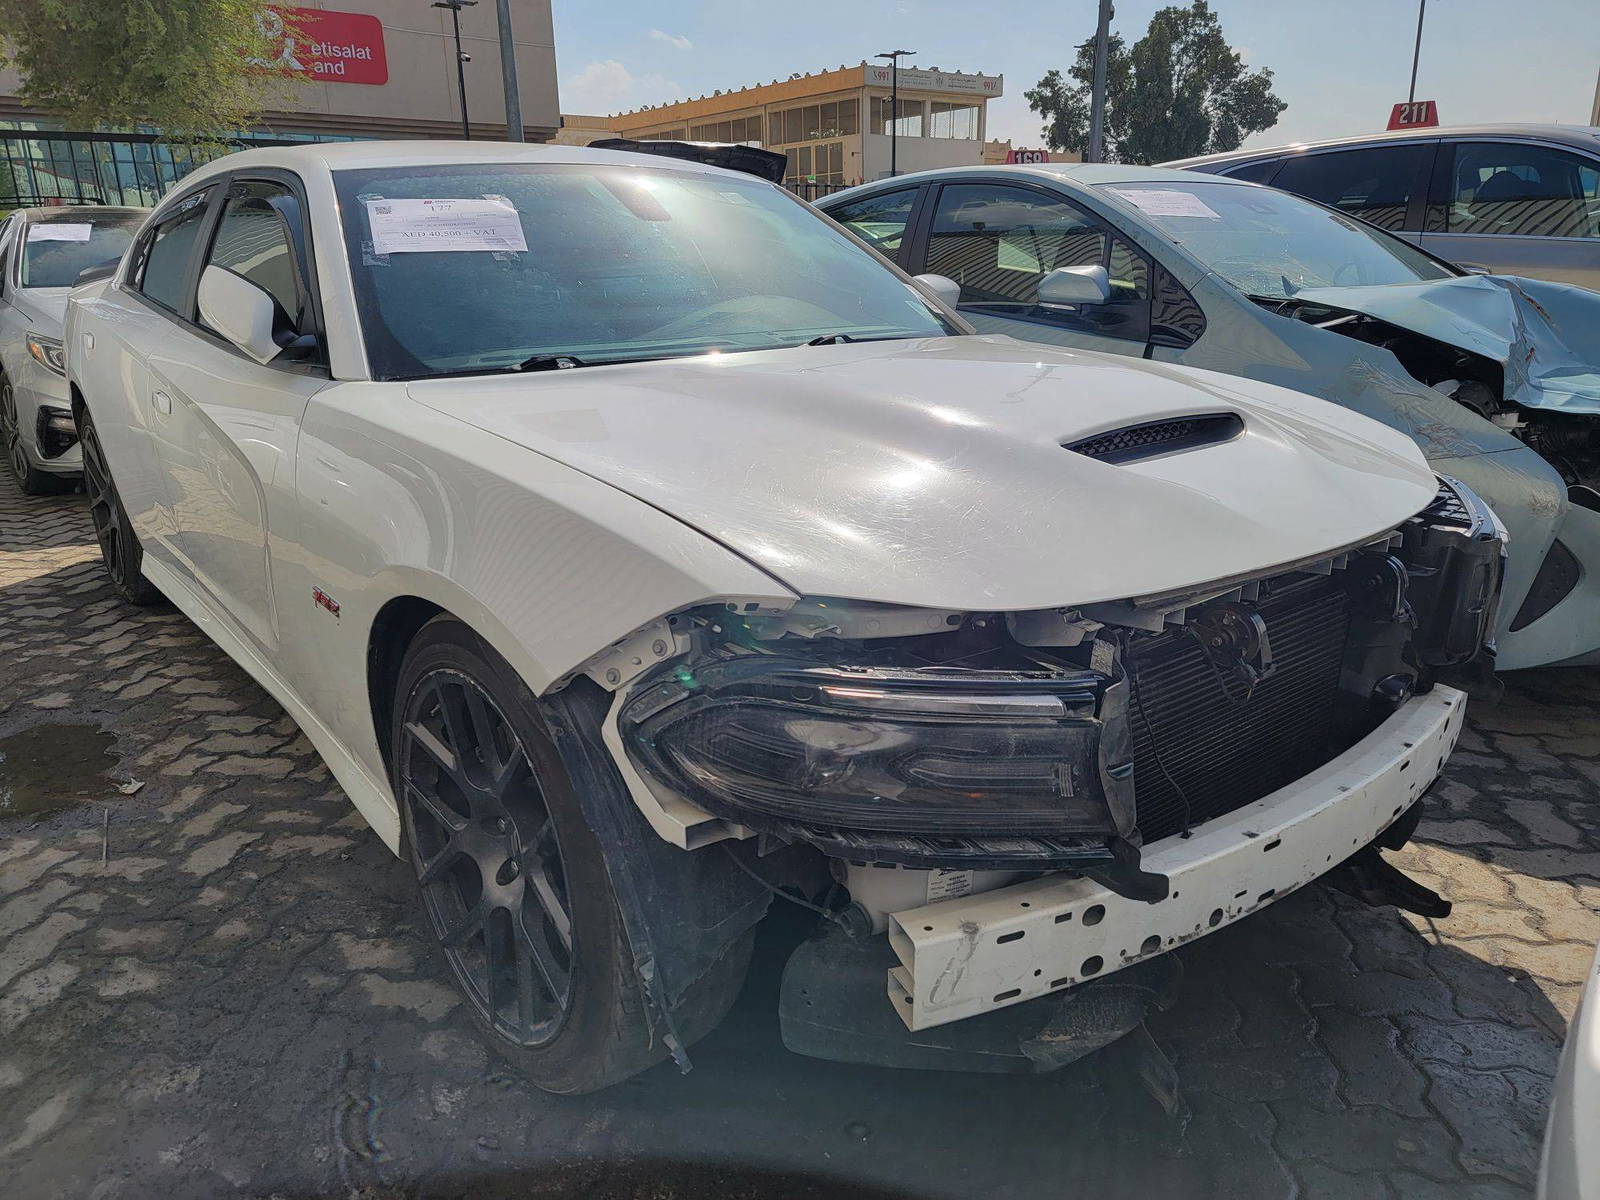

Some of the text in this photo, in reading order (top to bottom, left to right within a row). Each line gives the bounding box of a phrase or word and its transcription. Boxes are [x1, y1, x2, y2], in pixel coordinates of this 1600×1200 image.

[311, 42, 372, 60] etisalat
[314, 61, 345, 75] and
[1399, 103, 1427, 124] 211
[473, 228, 497, 236] VAT
